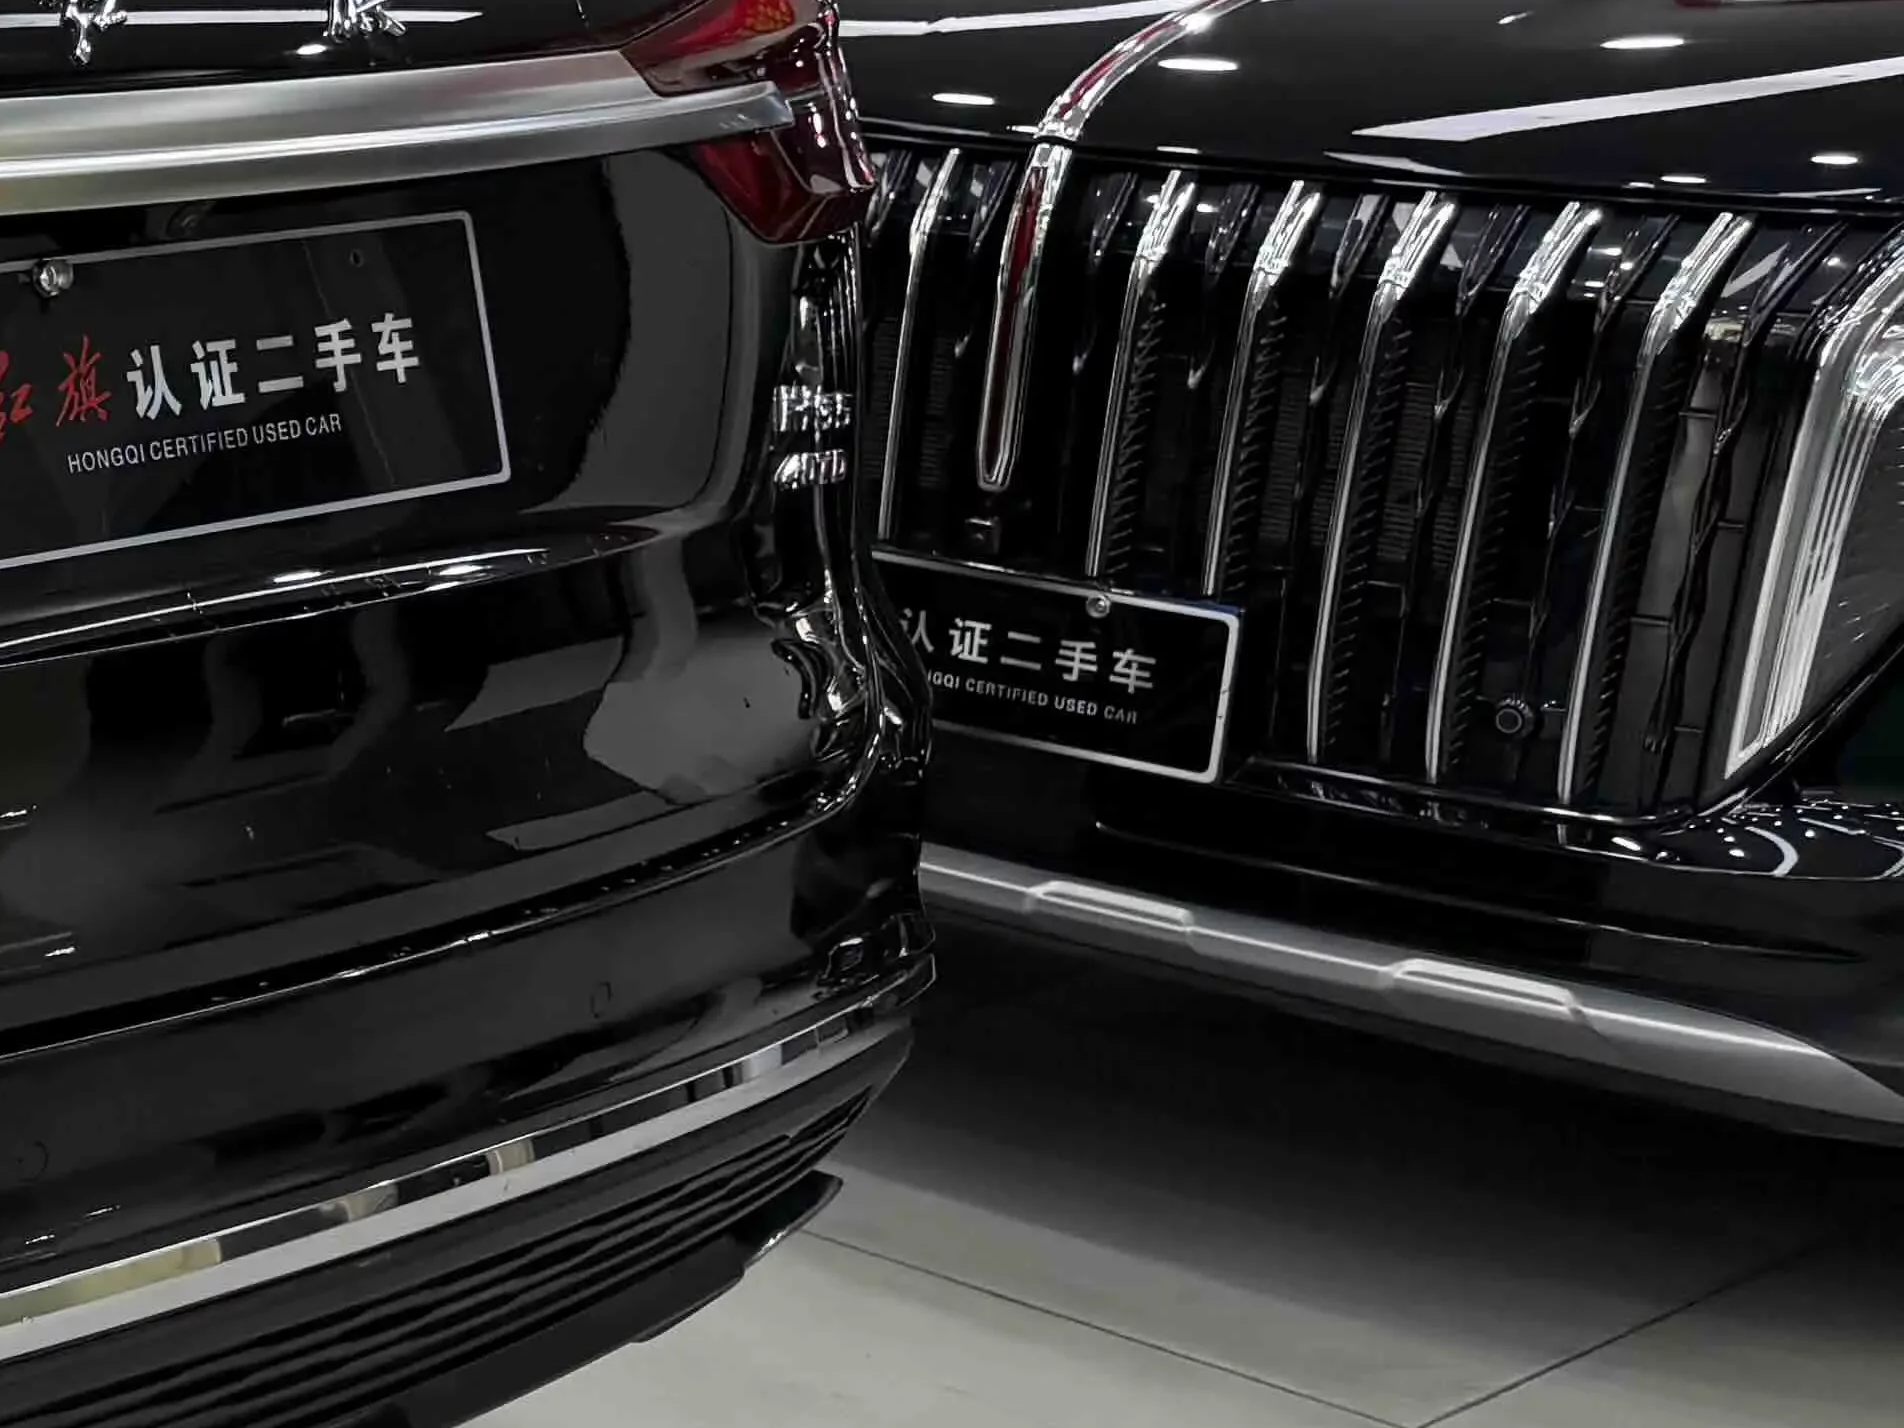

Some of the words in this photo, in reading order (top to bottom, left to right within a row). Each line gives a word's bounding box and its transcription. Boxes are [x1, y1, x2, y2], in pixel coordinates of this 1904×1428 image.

[67, 443, 145, 474] HONGQI
[149, 427, 248, 461] CERTIFIED
[252, 419, 301, 445] USED
[305, 413, 342, 436] CAR
[899, 607, 1157, 694] 认证二手车
[965, 677, 1049, 707] CERTIFIED
[1054, 694, 1098, 717] USED
